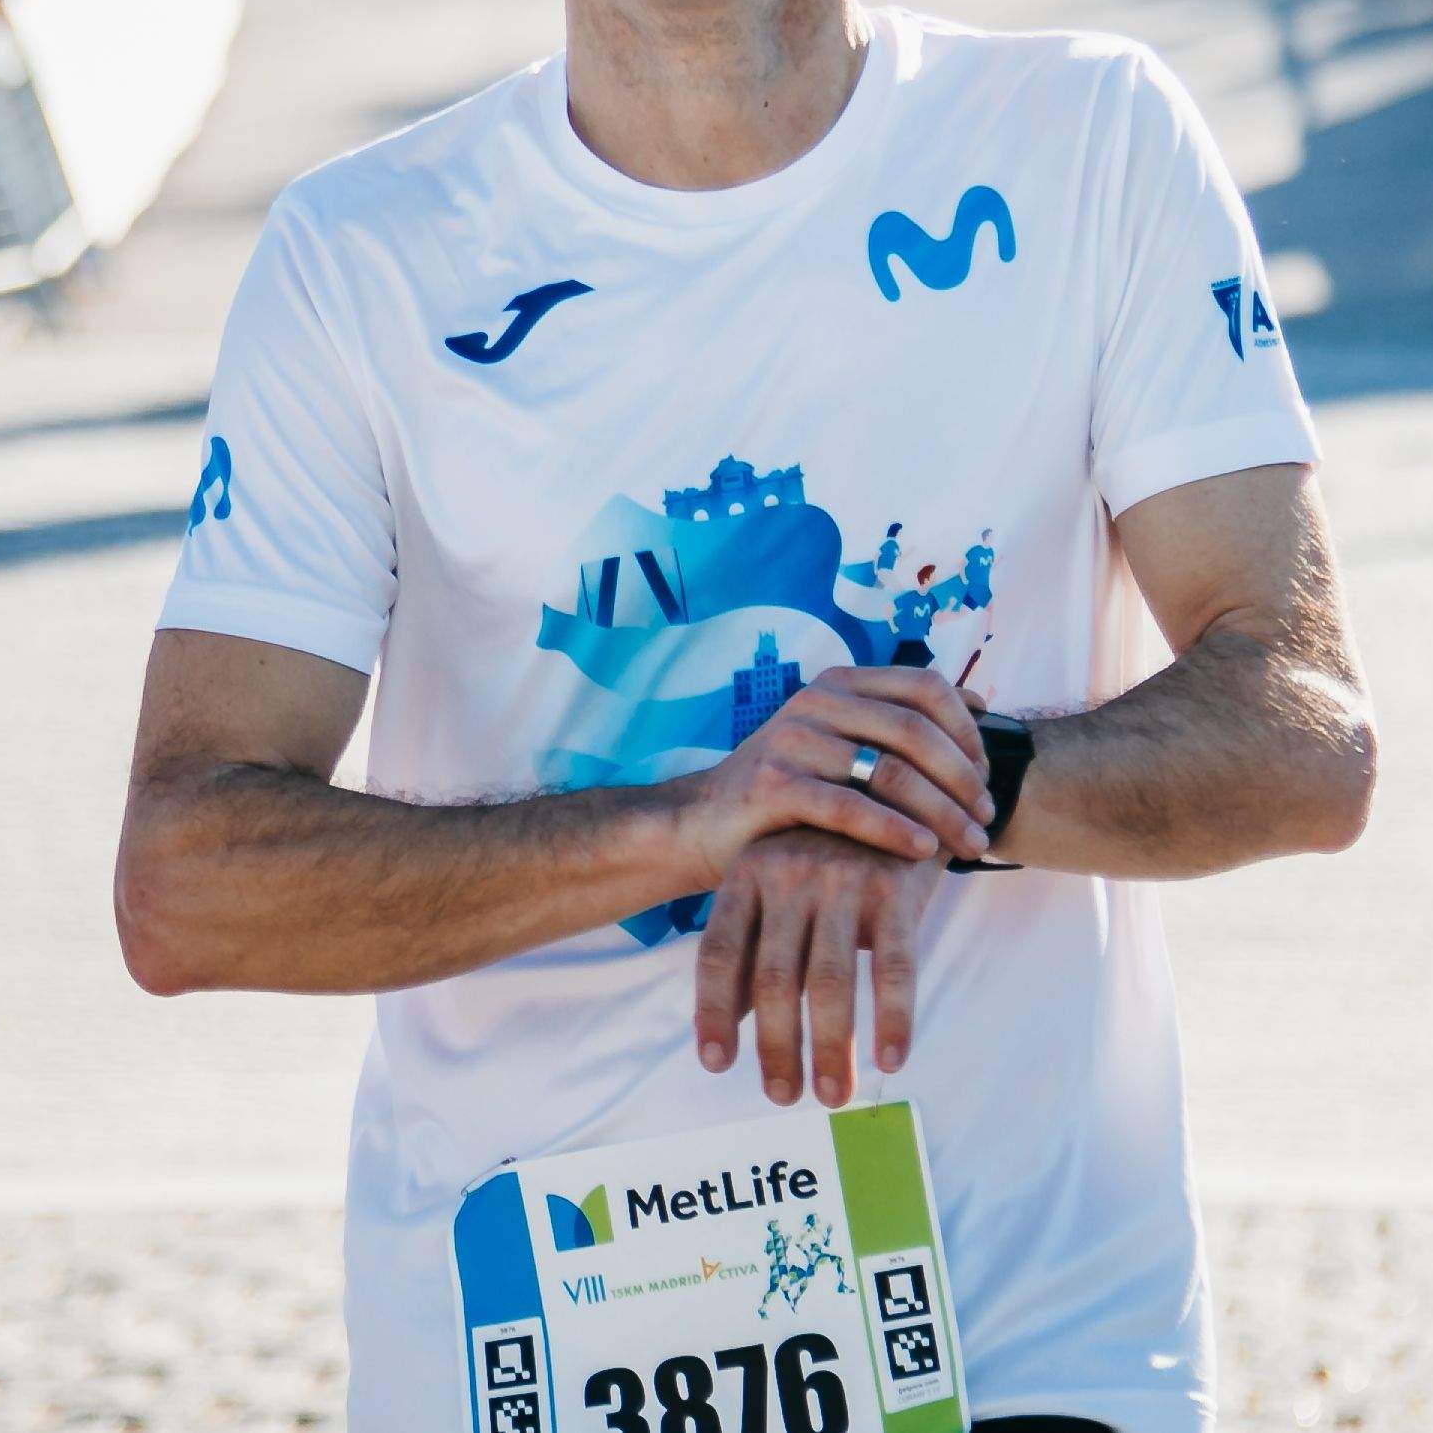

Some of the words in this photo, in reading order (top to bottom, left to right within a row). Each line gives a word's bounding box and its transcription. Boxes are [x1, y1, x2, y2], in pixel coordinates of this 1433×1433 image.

[626, 1160, 819, 1229] MetLife
[562, 1274, 607, 1306] VIII
[648, 1273, 702, 1293] MADRID
[584, 1332, 850, 1433] 3876
